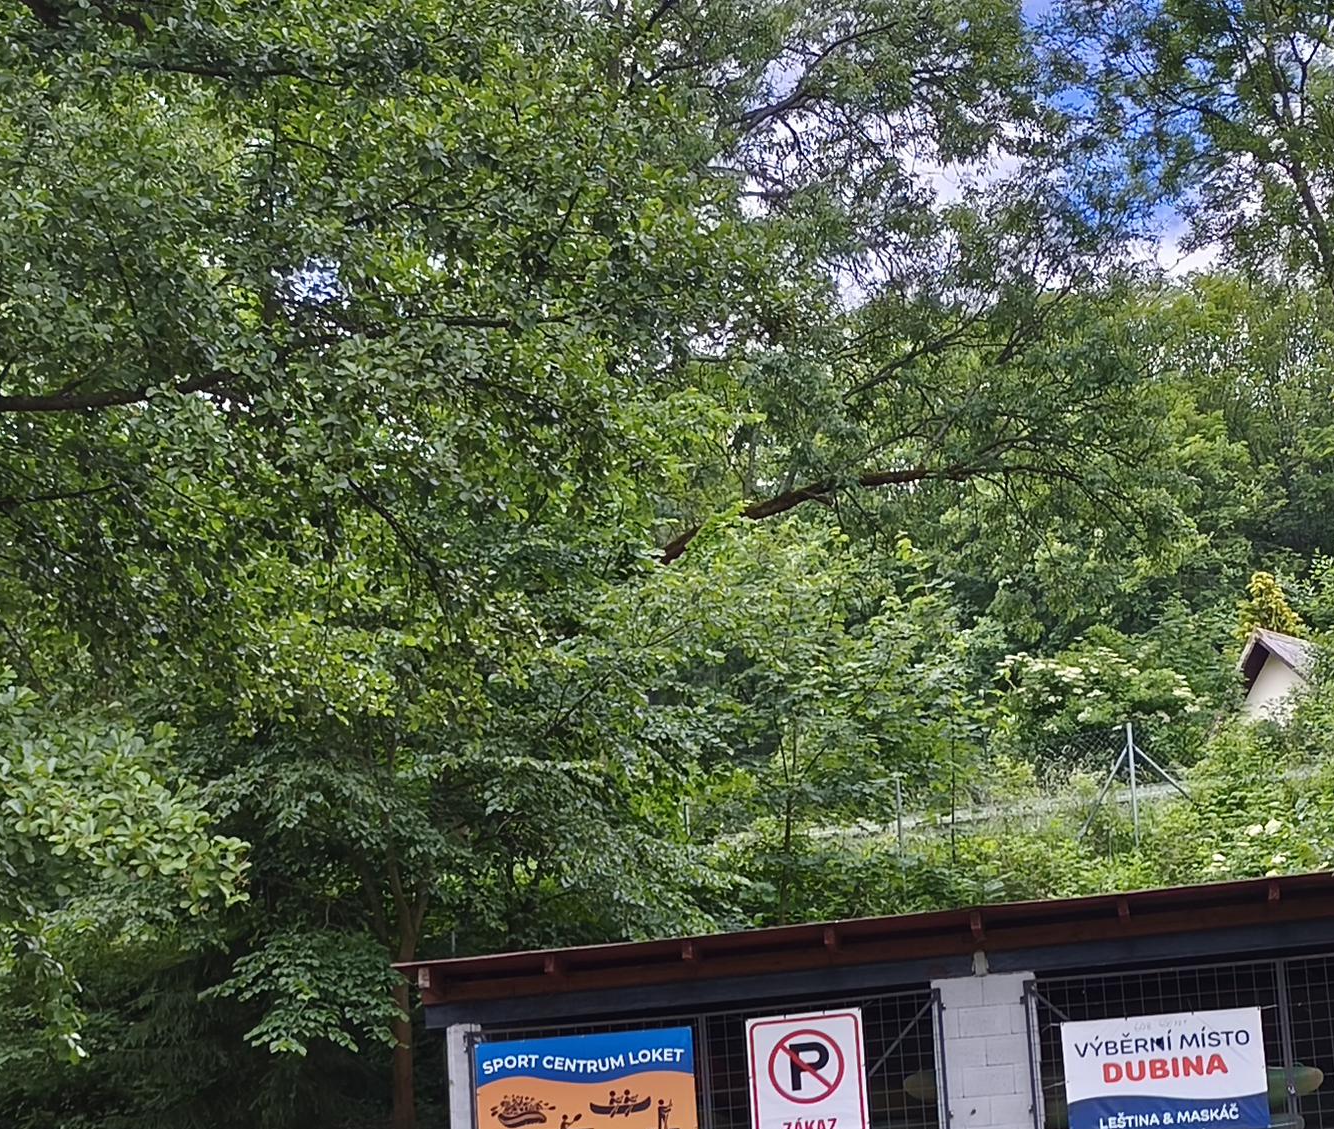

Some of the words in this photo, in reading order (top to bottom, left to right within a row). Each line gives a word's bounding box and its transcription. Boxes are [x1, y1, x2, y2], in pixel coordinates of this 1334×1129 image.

[1074, 1029, 1172, 1058] VÝBĚRNÍ
[1179, 1026, 1250, 1050] MÍSTO
[482, 1054, 539, 1075] SPORT
[542, 1055, 625, 1073] CENTRUM
[628, 1048, 685, 1066] LOKET
[789, 1042, 830, 1091] P
[1103, 1053, 1228, 1084] DUBINA
[1099, 1112, 1159, 1129] LEŠTINA
[1163, 1112, 1174, 1125] &
[1177, 1102, 1239, 1124] MASKÁČ
